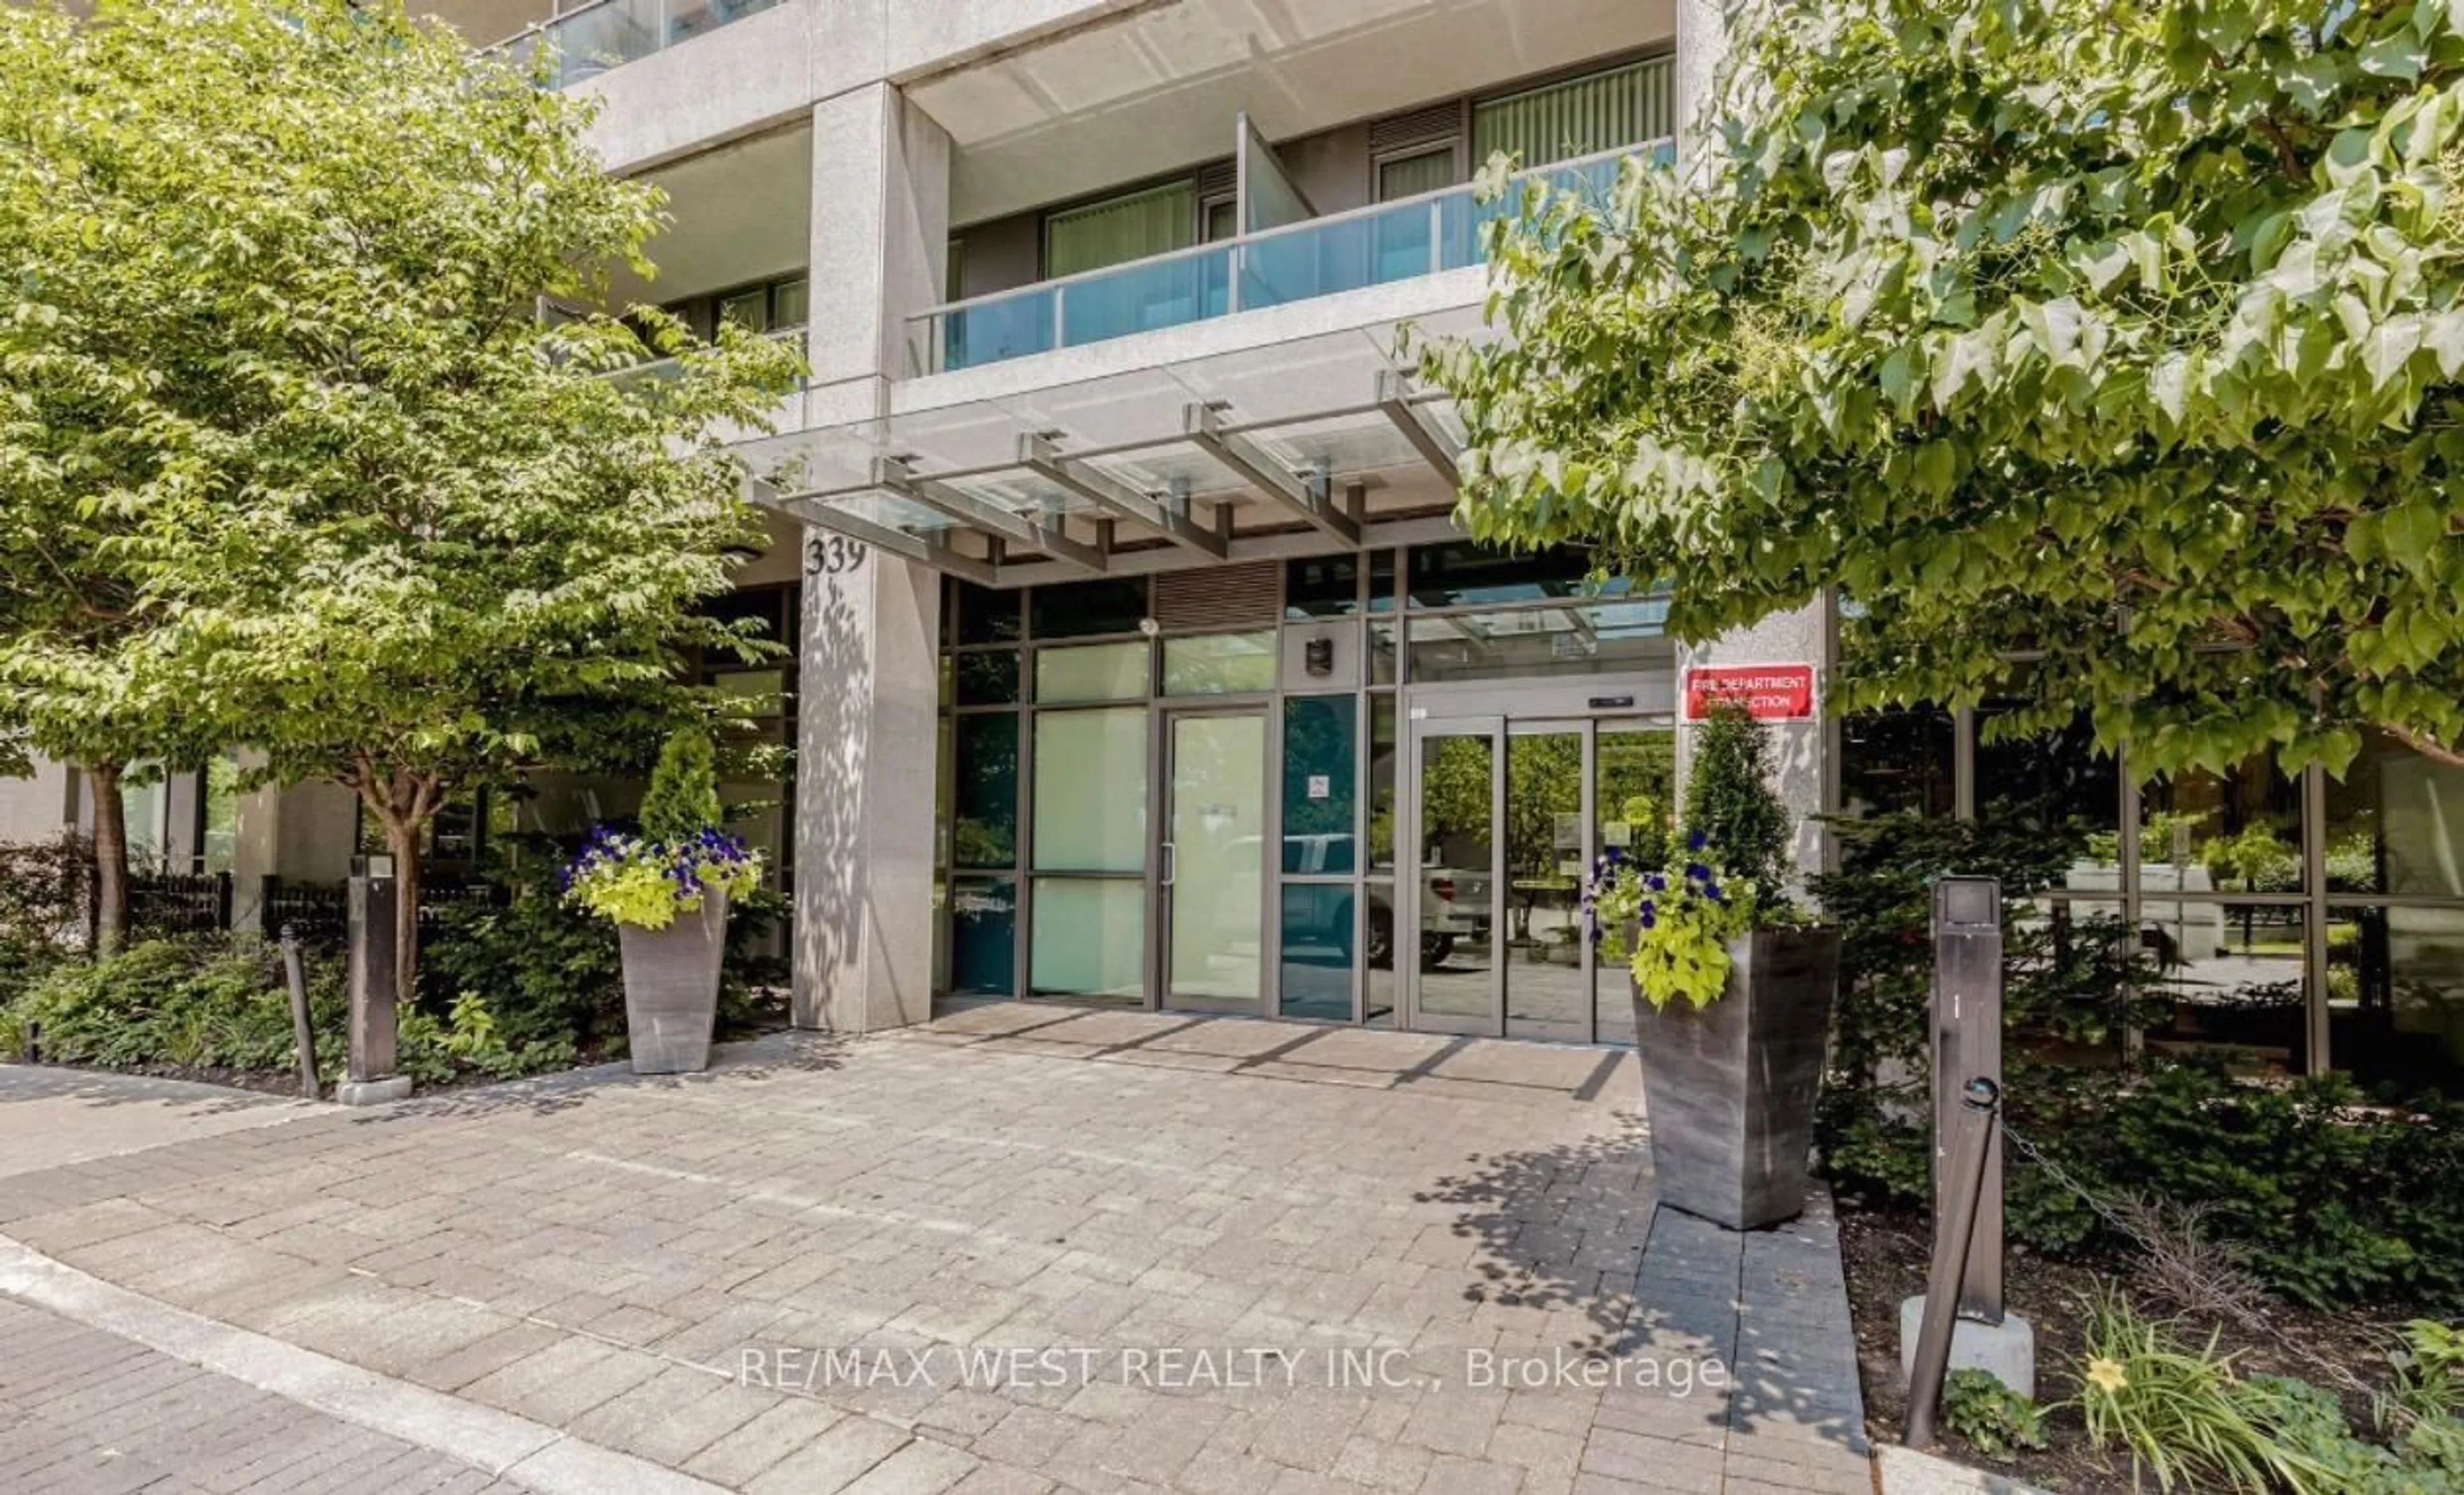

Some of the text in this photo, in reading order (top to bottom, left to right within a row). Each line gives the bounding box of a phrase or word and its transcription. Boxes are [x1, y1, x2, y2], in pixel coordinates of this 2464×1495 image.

[806, 536, 865, 576] 339
[1691, 676, 1806, 692] FIRE DEPARTMENT
[1706, 695, 1790, 709] NCTION
